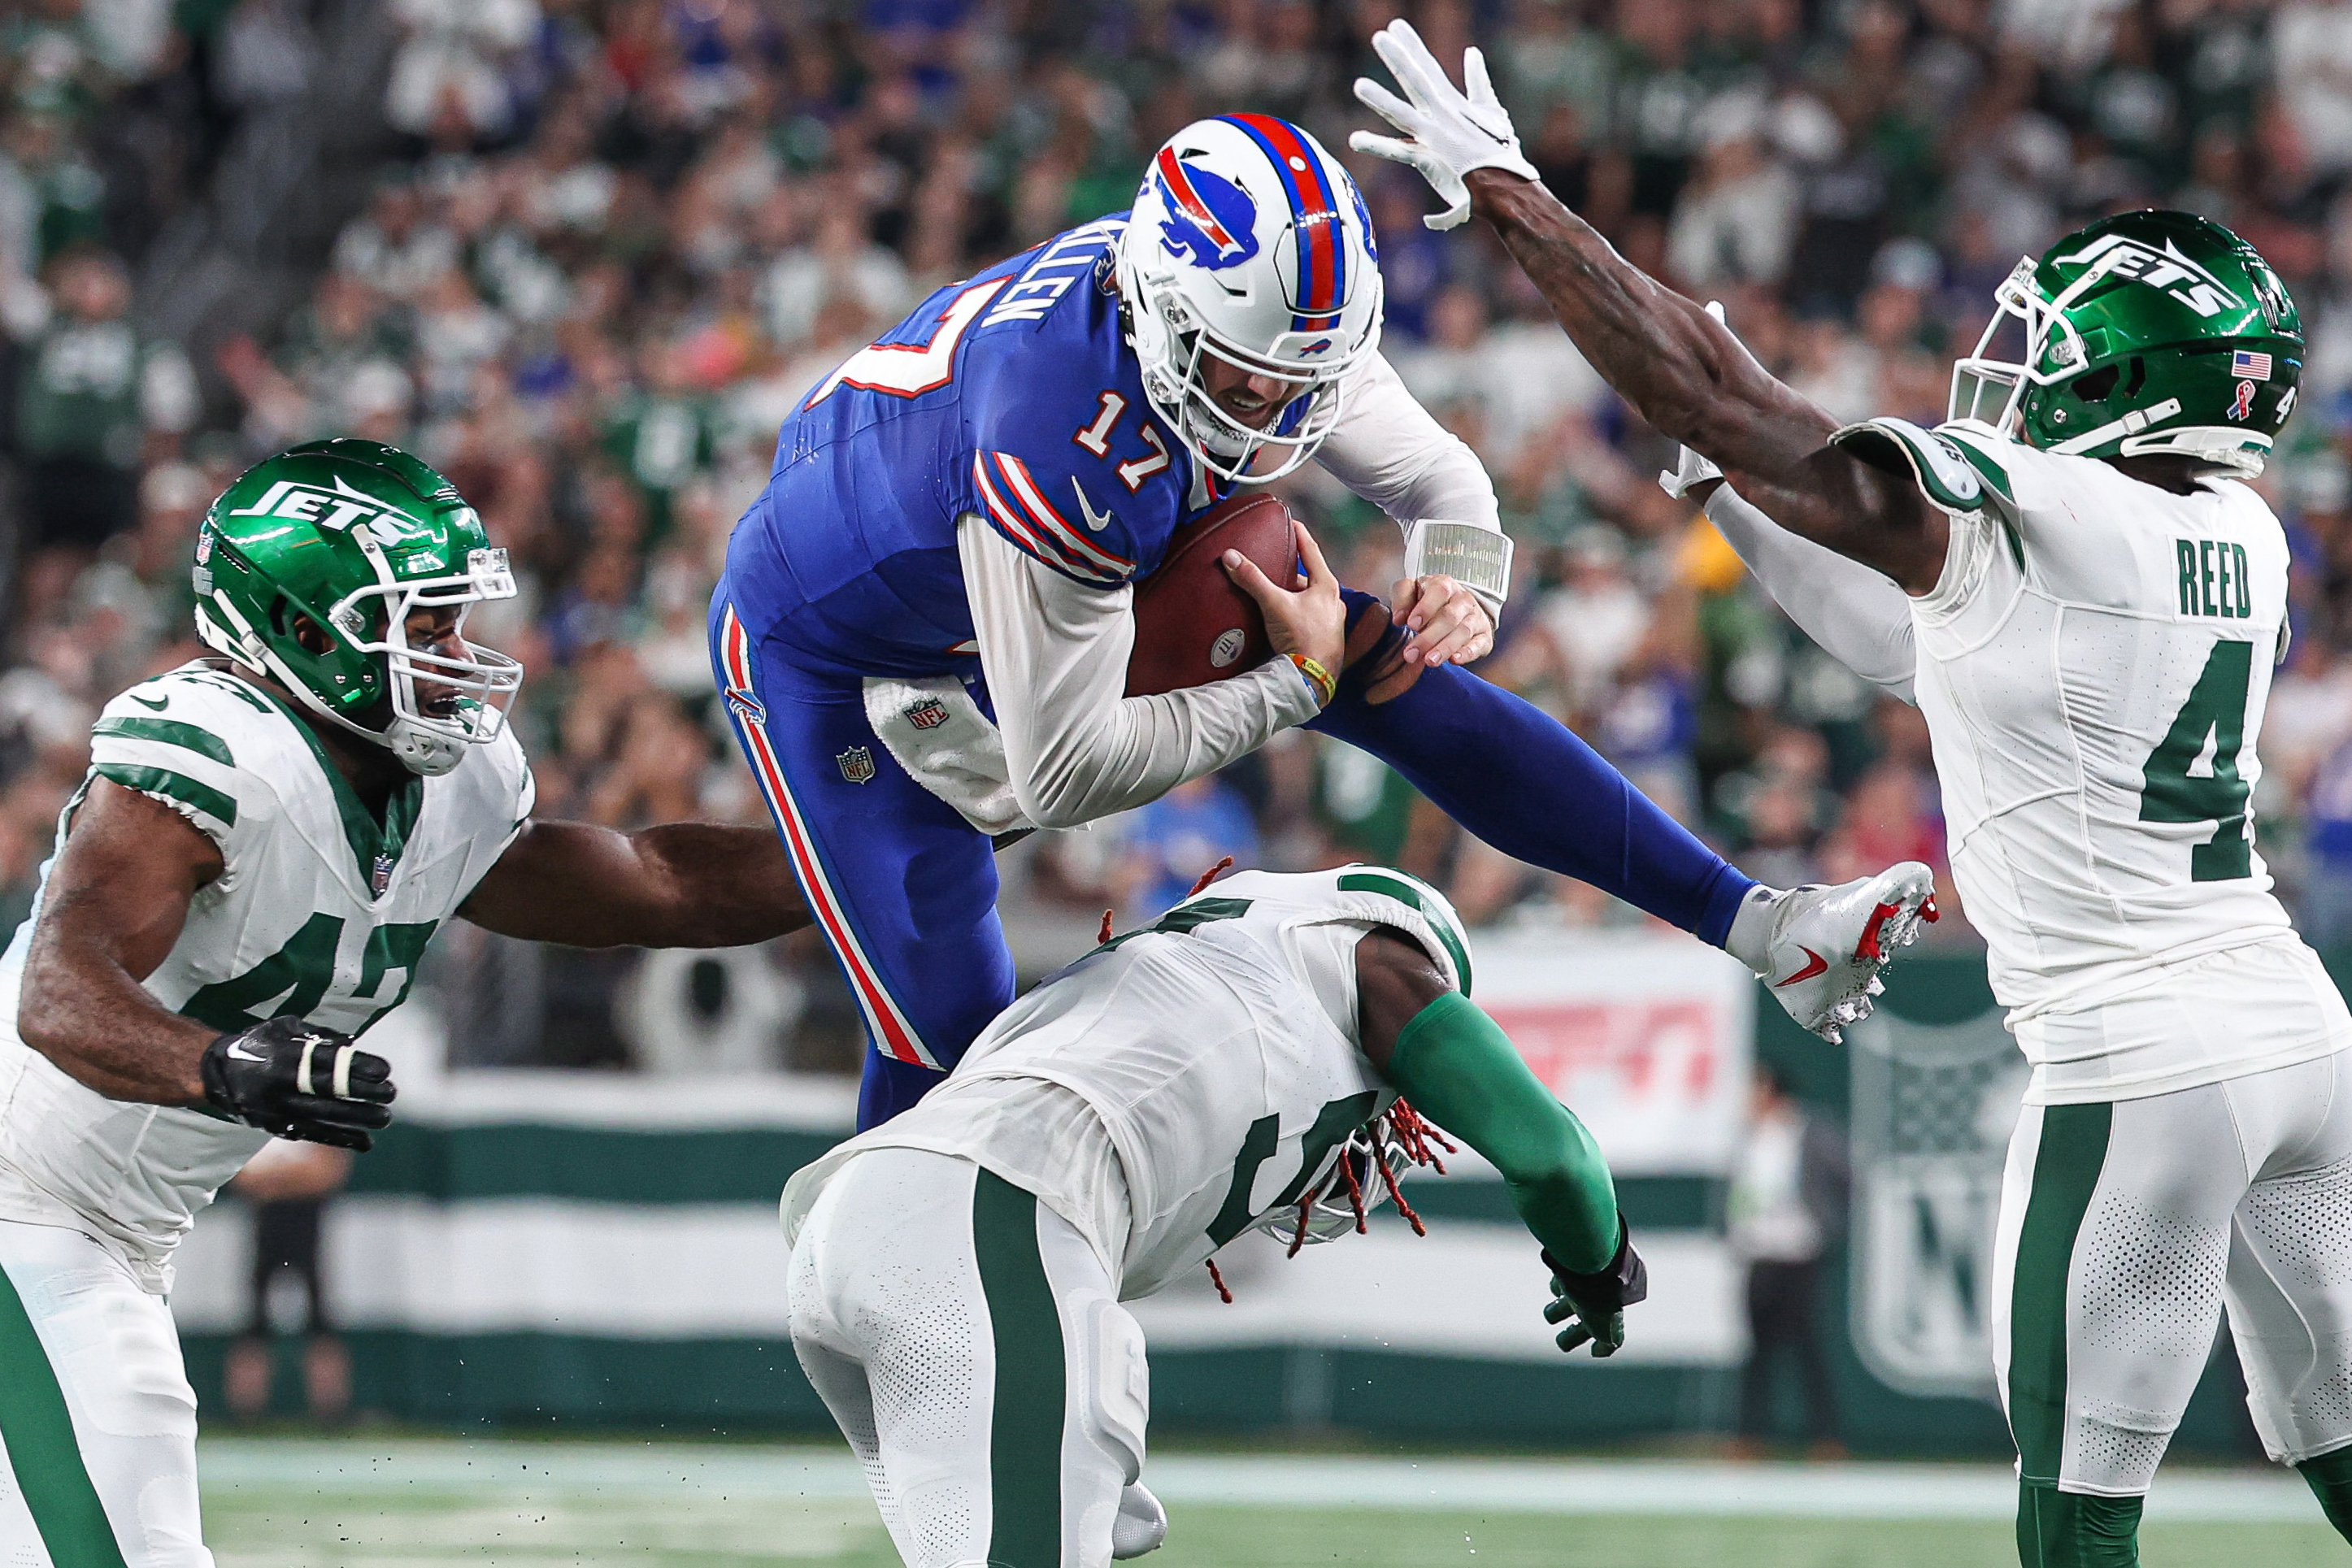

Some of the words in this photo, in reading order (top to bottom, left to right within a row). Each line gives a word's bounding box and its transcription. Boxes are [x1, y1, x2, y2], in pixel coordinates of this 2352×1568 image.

[2050, 232, 2248, 319] JETS
[1073, 389, 1171, 495] 17
[2276, 385, 2297, 425] 4
[228, 474, 424, 548] JETS
[2176, 538, 2251, 619] REED
[911, 706, 946, 728] NFL
[846, 762, 870, 778] NFL
[2138, 639, 2254, 883] 4
